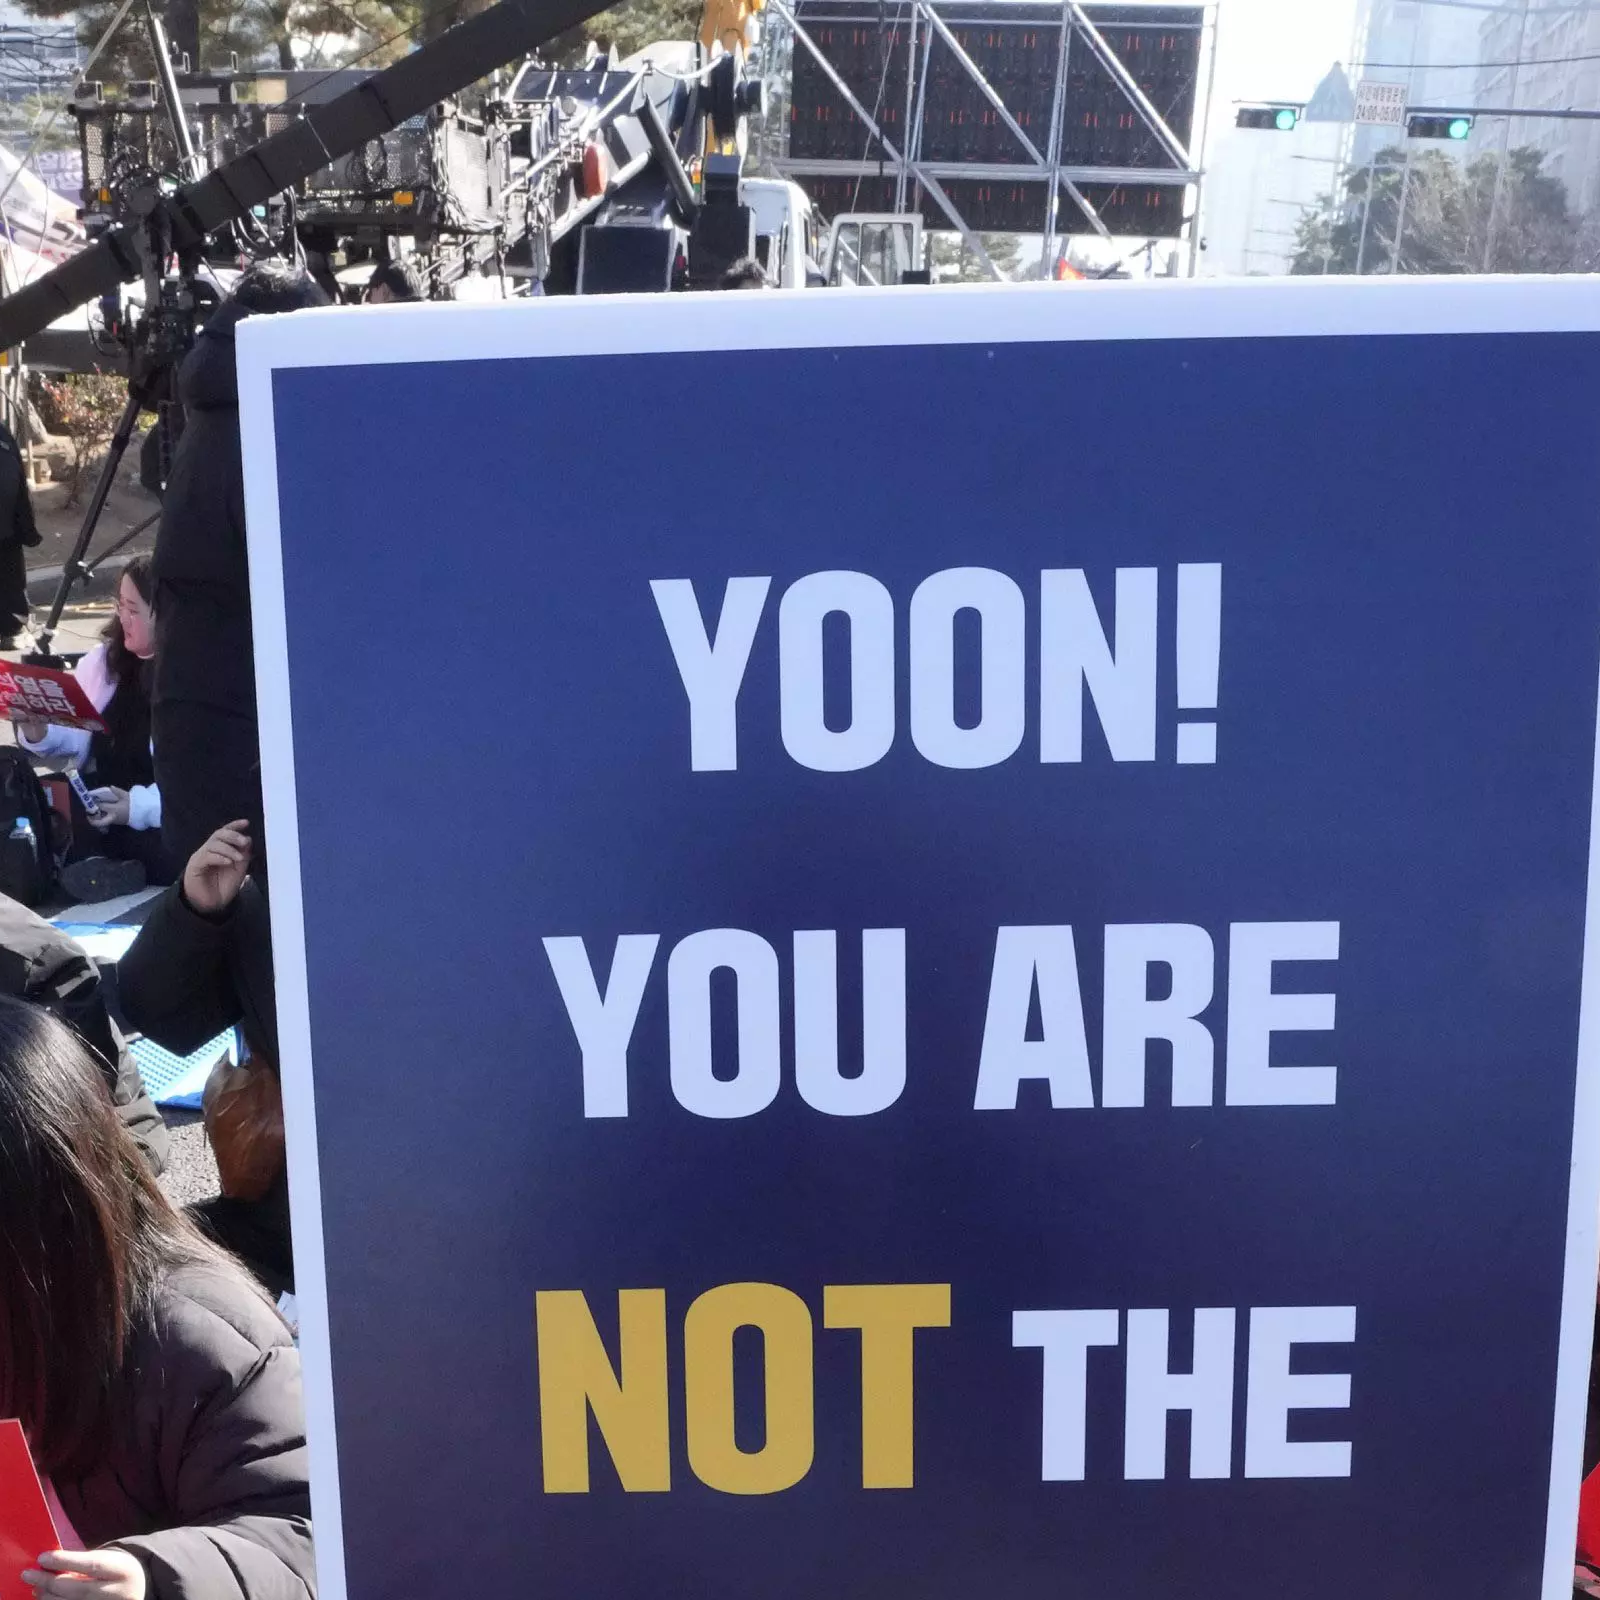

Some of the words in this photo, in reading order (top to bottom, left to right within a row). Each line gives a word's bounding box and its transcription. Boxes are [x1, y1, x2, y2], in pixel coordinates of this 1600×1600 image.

[650, 563, 1223, 772] YOON!
[542, 928, 907, 1118] YOU
[973, 921, 1340, 1109] ARE
[536, 1283, 952, 1495] NOT
[1012, 1306, 1357, 1482] THE
